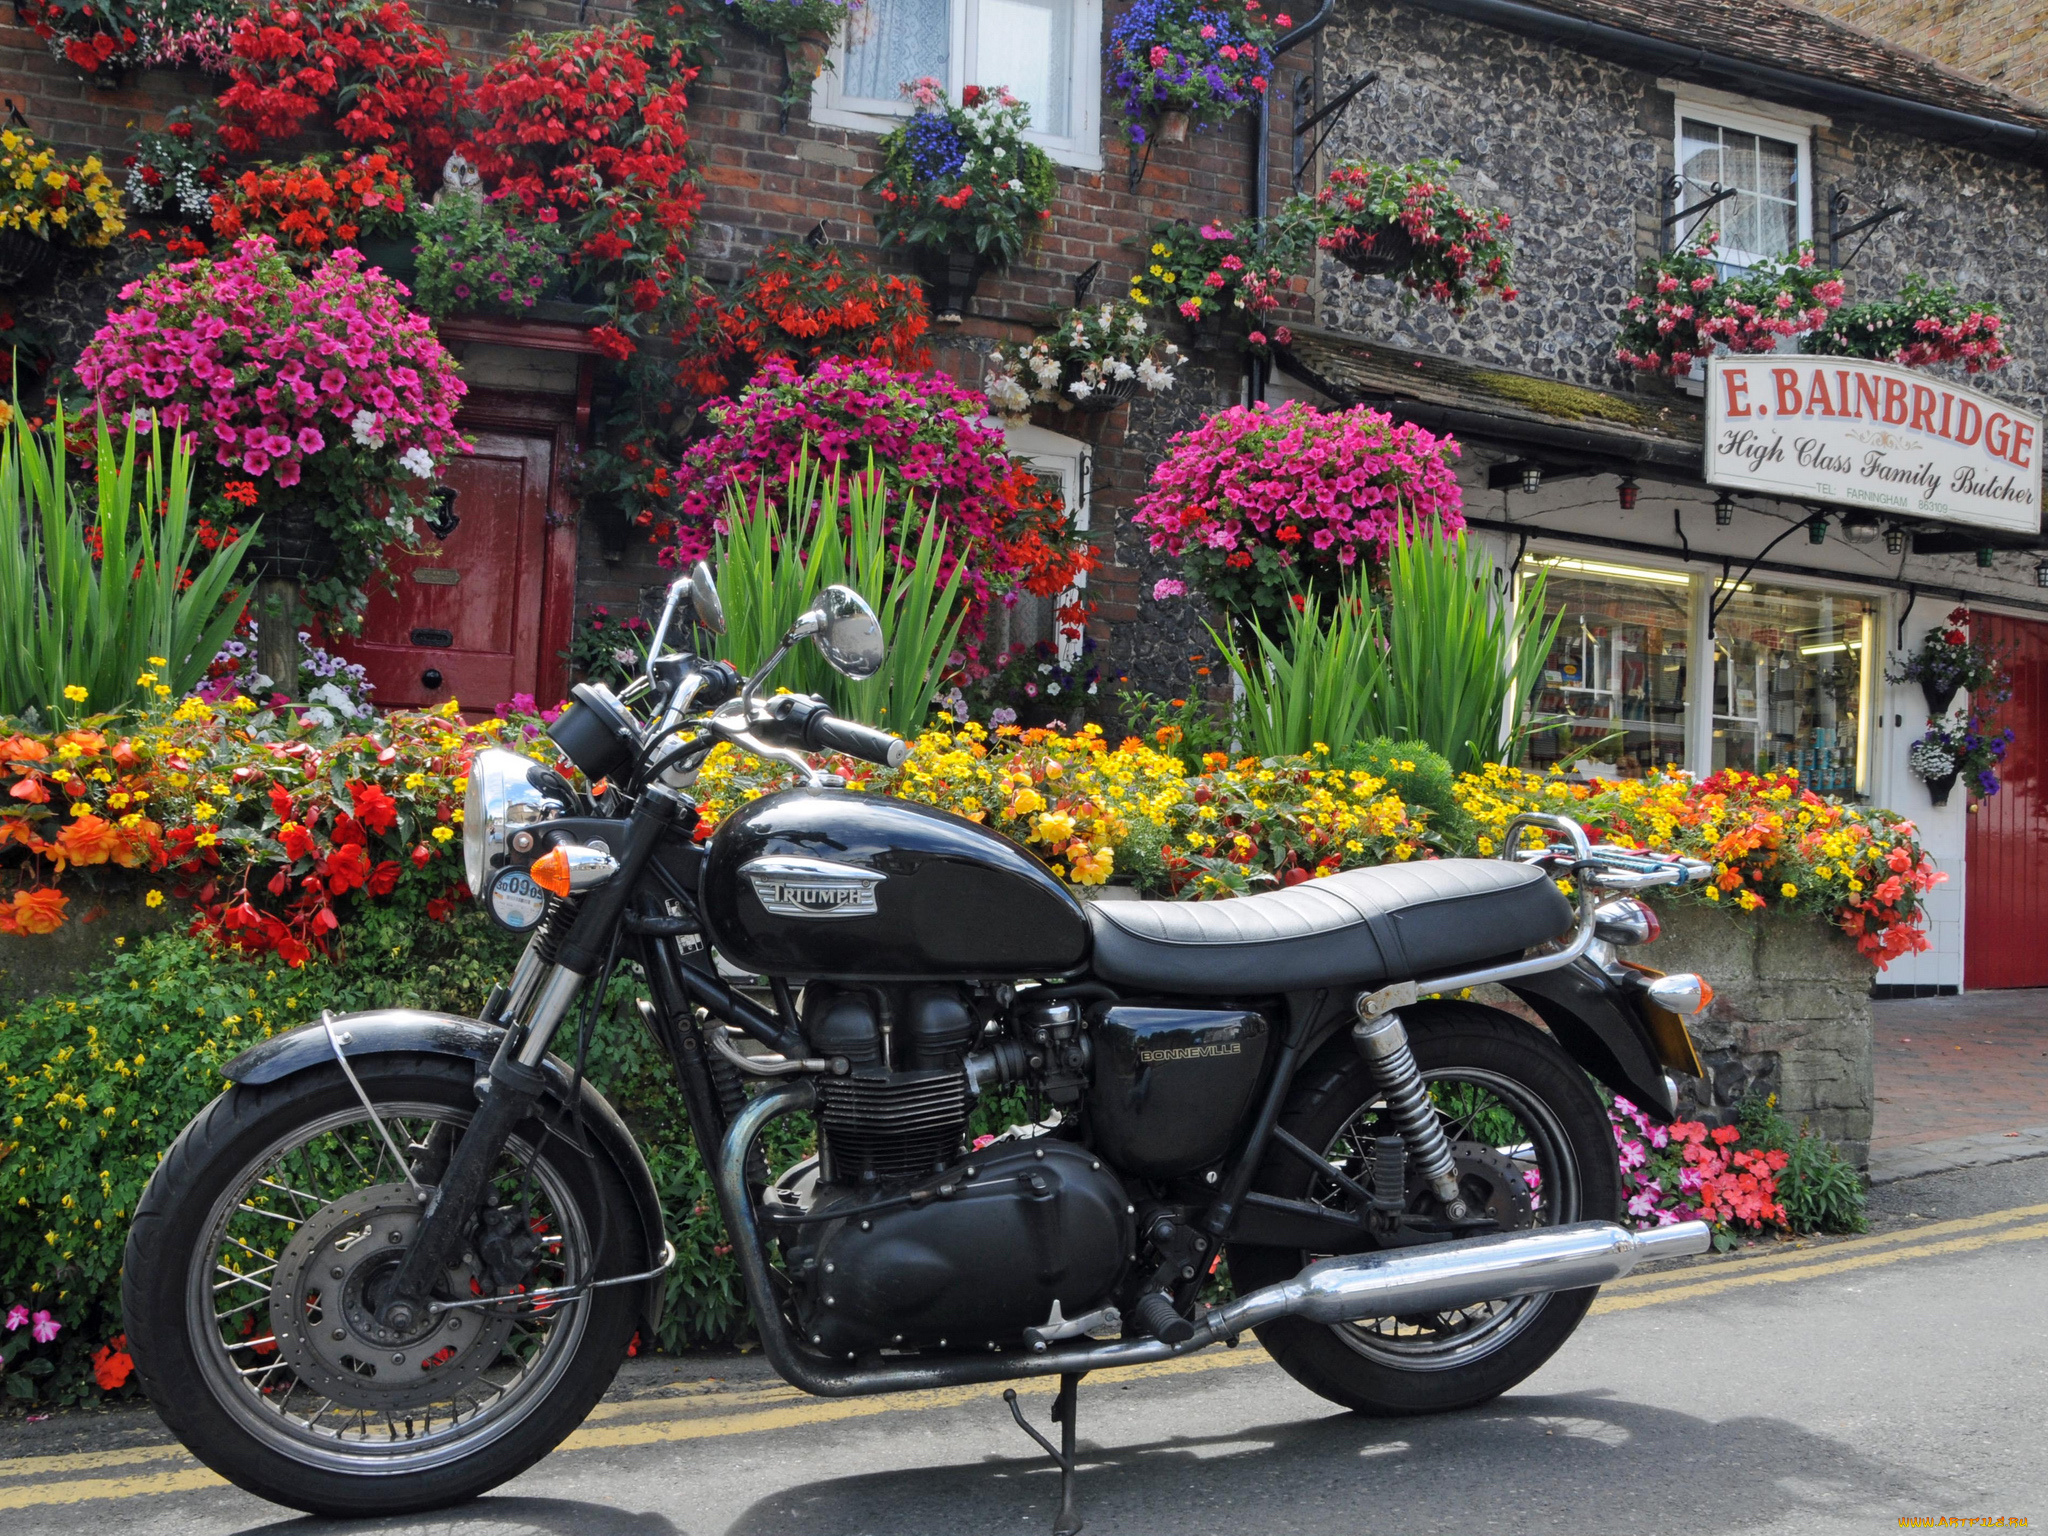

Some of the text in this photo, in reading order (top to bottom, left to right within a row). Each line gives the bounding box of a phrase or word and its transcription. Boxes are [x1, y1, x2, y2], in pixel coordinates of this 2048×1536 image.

[1722, 367, 2034, 469] E. BAINBRIDGE
[1718, 429, 2034, 505] High Class Family Butcher
[1847, 487, 1908, 508] FARNINGHAM
[1918, 499, 1949, 514] 863109
[510, 877, 530, 896] 09
[770, 882, 862, 906] TRIUMPH
[1141, 1043, 1241, 1061] BONNEVILLE
